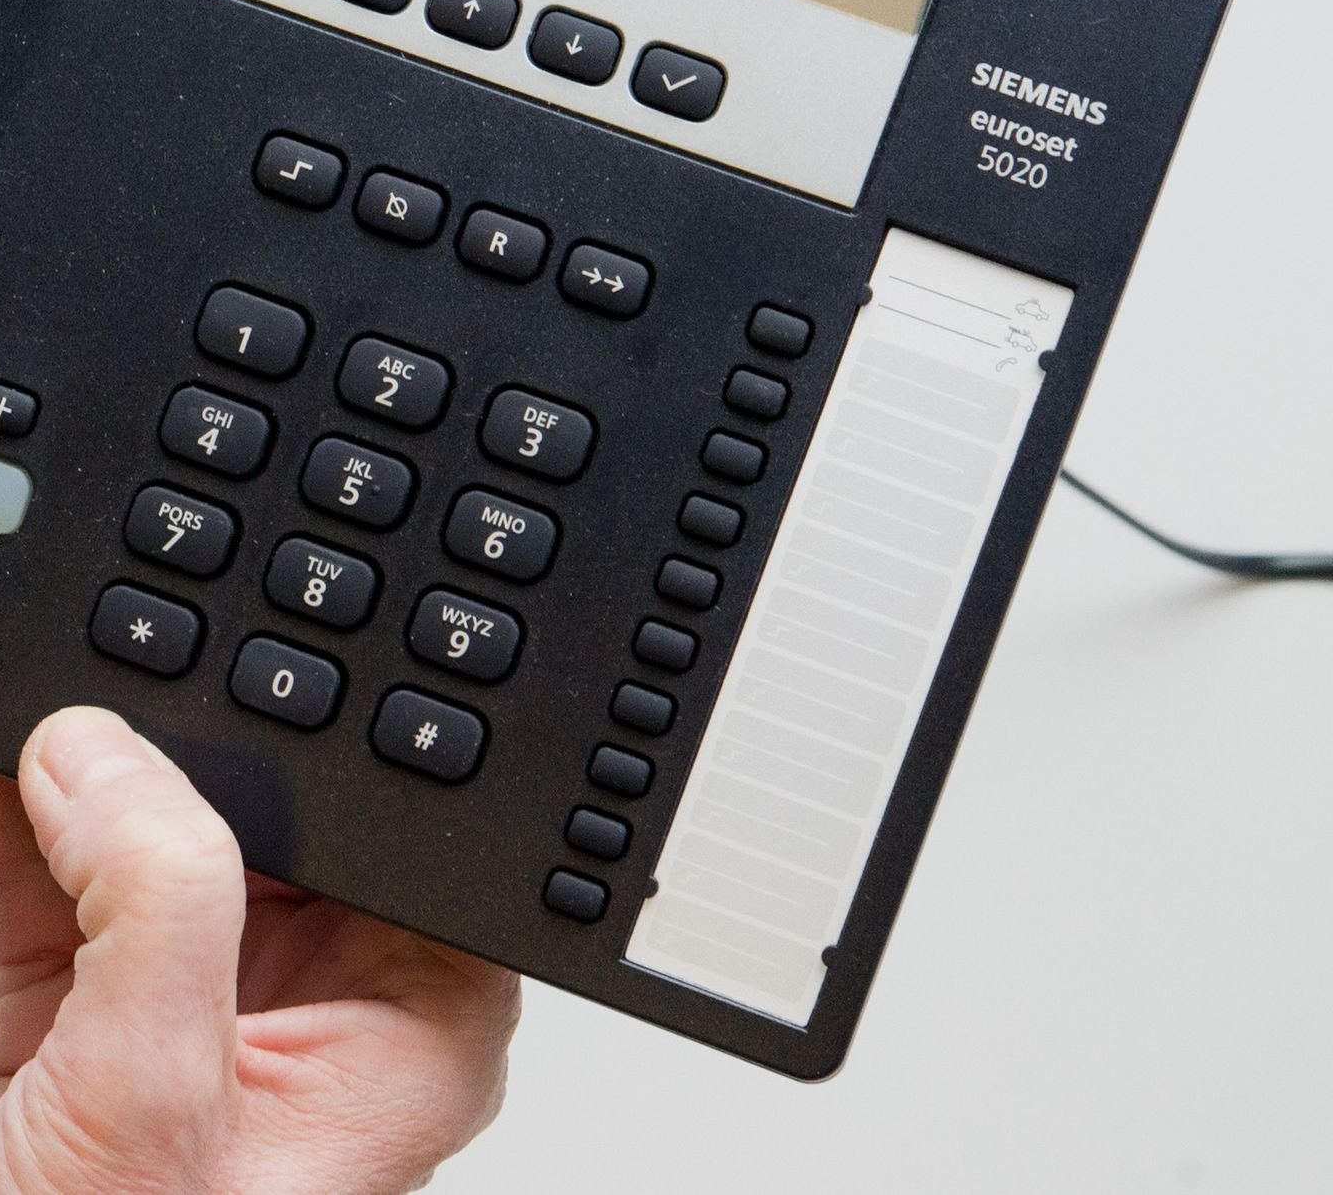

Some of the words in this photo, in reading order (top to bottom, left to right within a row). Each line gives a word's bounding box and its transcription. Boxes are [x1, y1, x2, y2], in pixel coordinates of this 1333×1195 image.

[971, 62, 1108, 125] SIEMENS
[970, 110, 1078, 162] euroset
[976, 144, 1048, 189] 5020
[489, 230, 508, 256] R
[238, 325, 253, 354] 1
[377, 355, 416, 380] ABC
[374, 376, 399, 407] 2
[201, 406, 234, 429] GHI
[523, 406, 559, 430] DEF
[197, 427, 220, 456] 4
[518, 427, 543, 457] 3
[343, 456, 373, 480] JKL
[338, 475, 363, 506] 5
[158, 502, 204, 531] PQRS
[481, 506, 526, 534] MNO
[161, 523, 186, 552] 7
[484, 530, 508, 559] 6
[307, 555, 343, 581] TUV
[303, 576, 327, 607] 8
[442, 604, 495, 638] WXYZ
[447, 630, 470, 658] 9
[271, 668, 295, 699] 0
